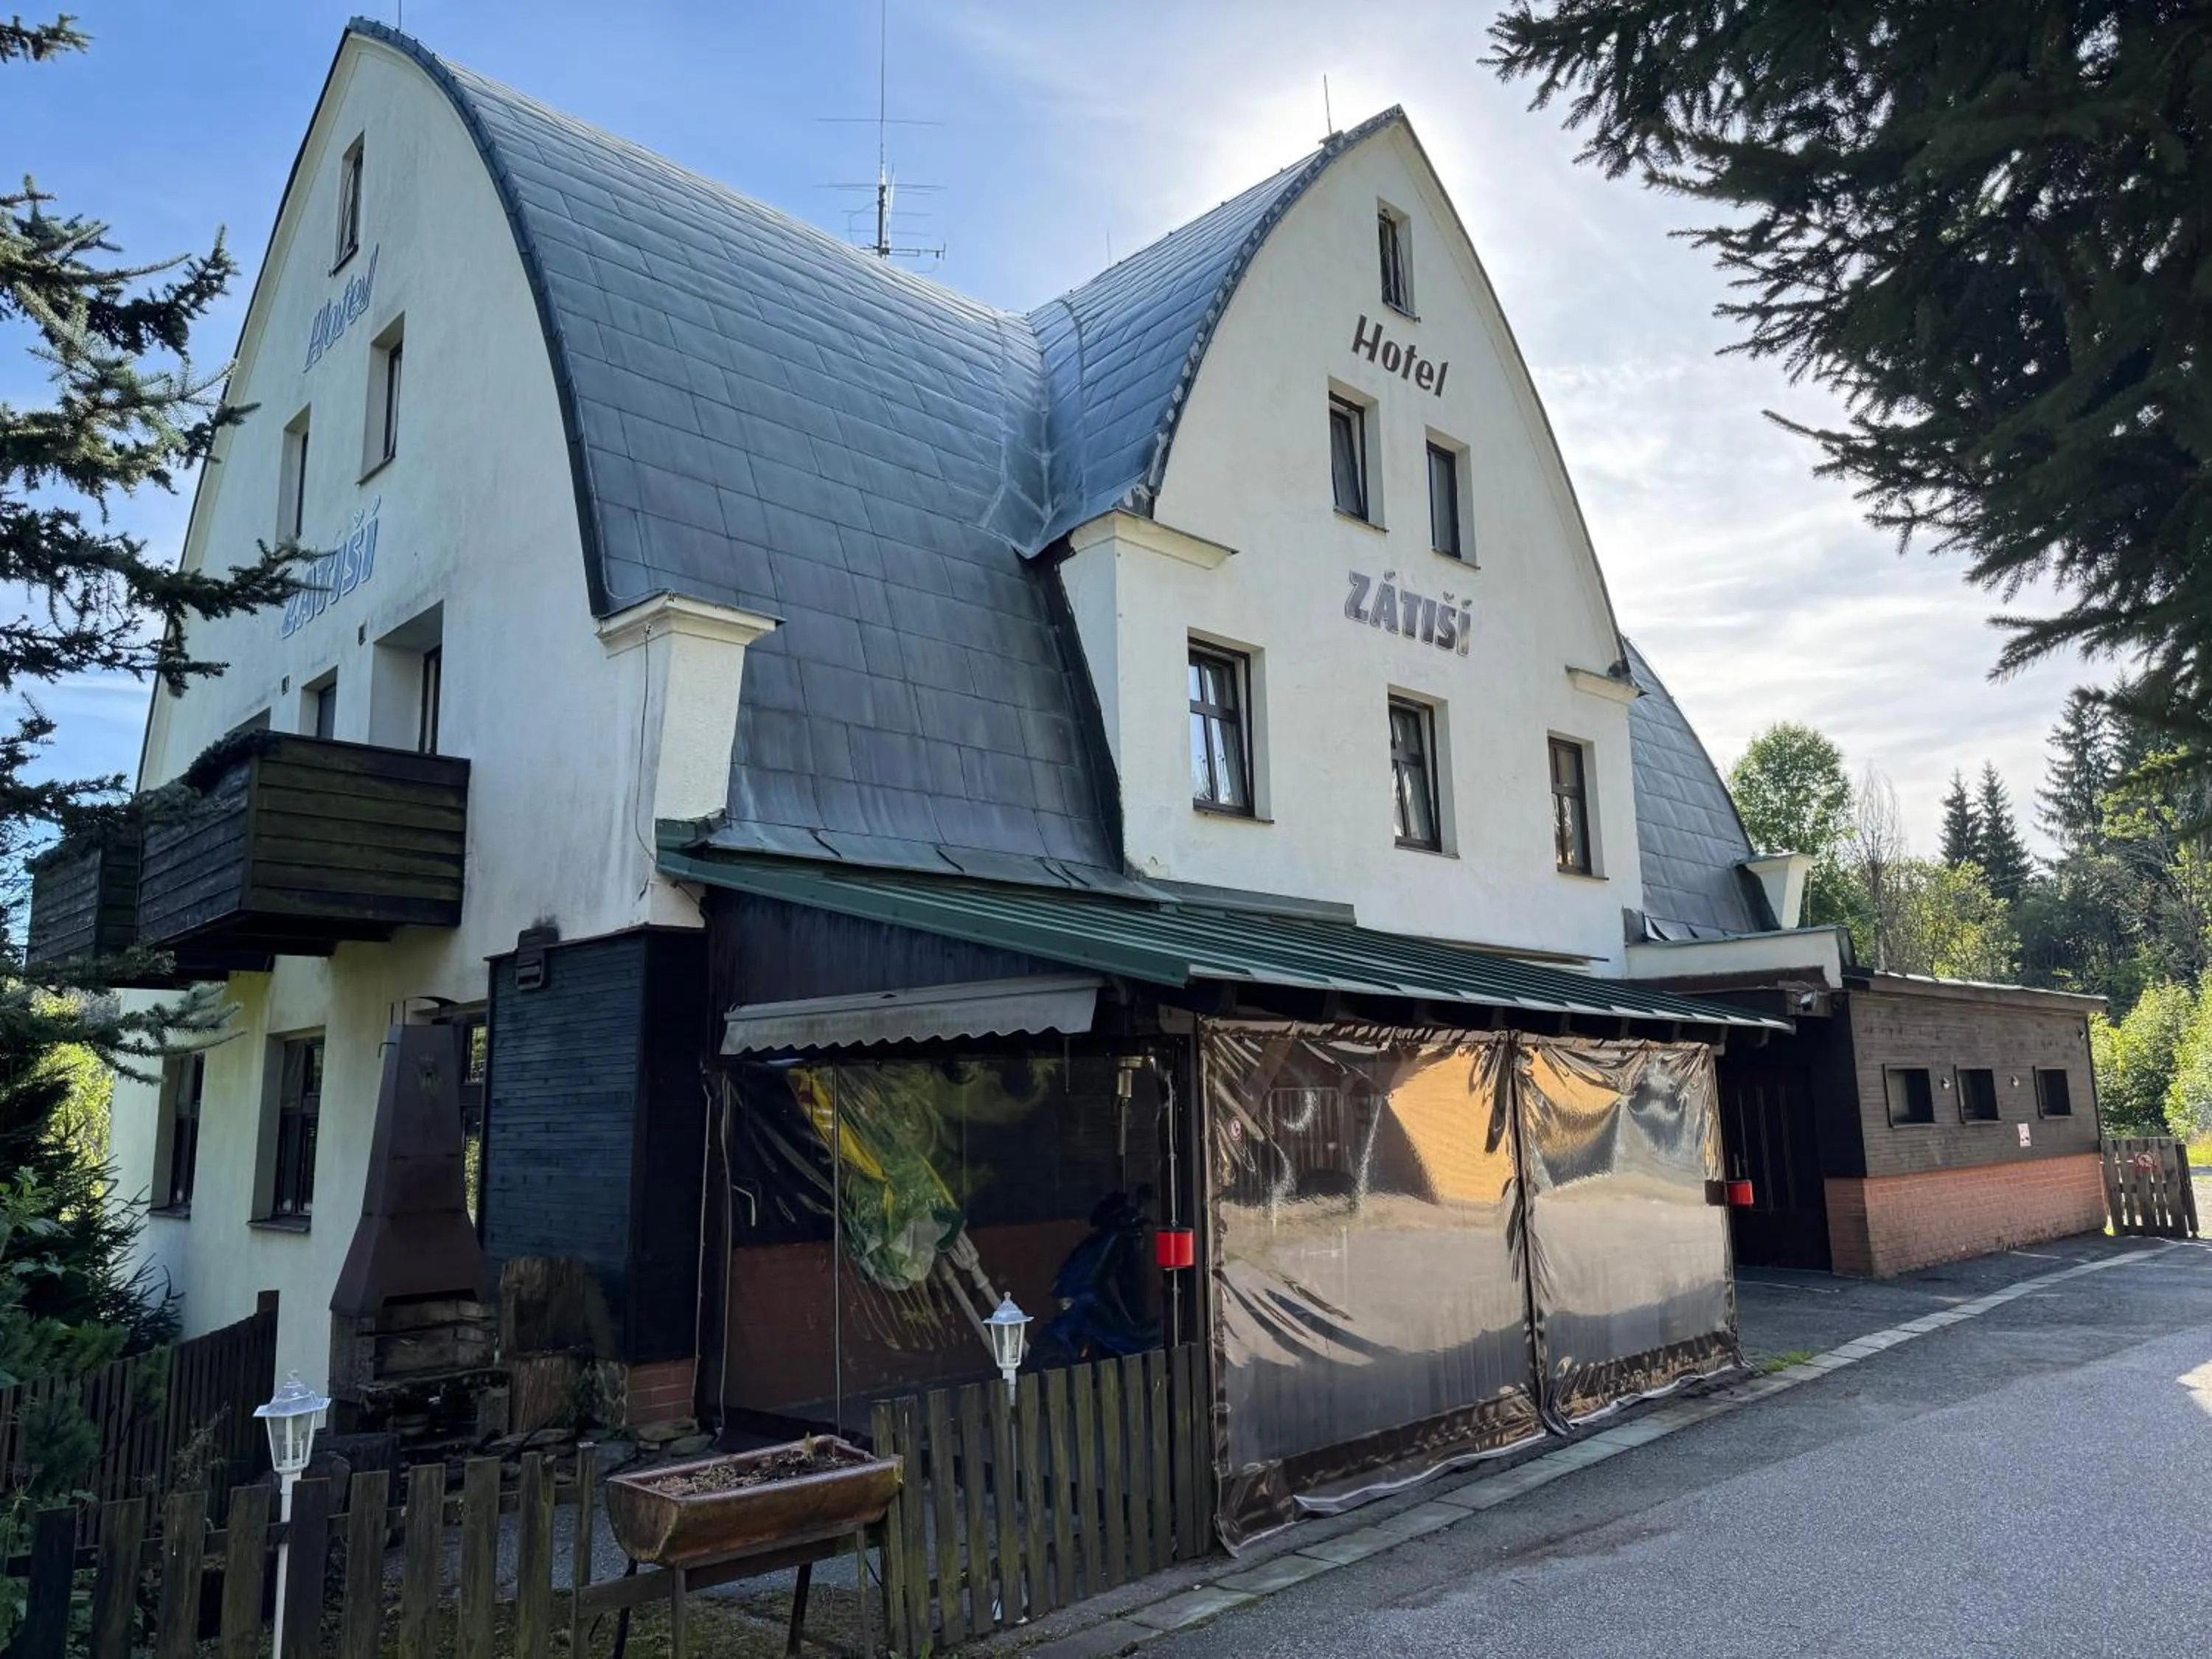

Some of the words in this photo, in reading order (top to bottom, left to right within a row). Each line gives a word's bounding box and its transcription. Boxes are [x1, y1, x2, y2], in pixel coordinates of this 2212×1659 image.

[303, 242, 380, 373] Hotel
[1351, 313, 1450, 398] Hotel
[1344, 568, 1473, 658] ZÁTIŠÍ
